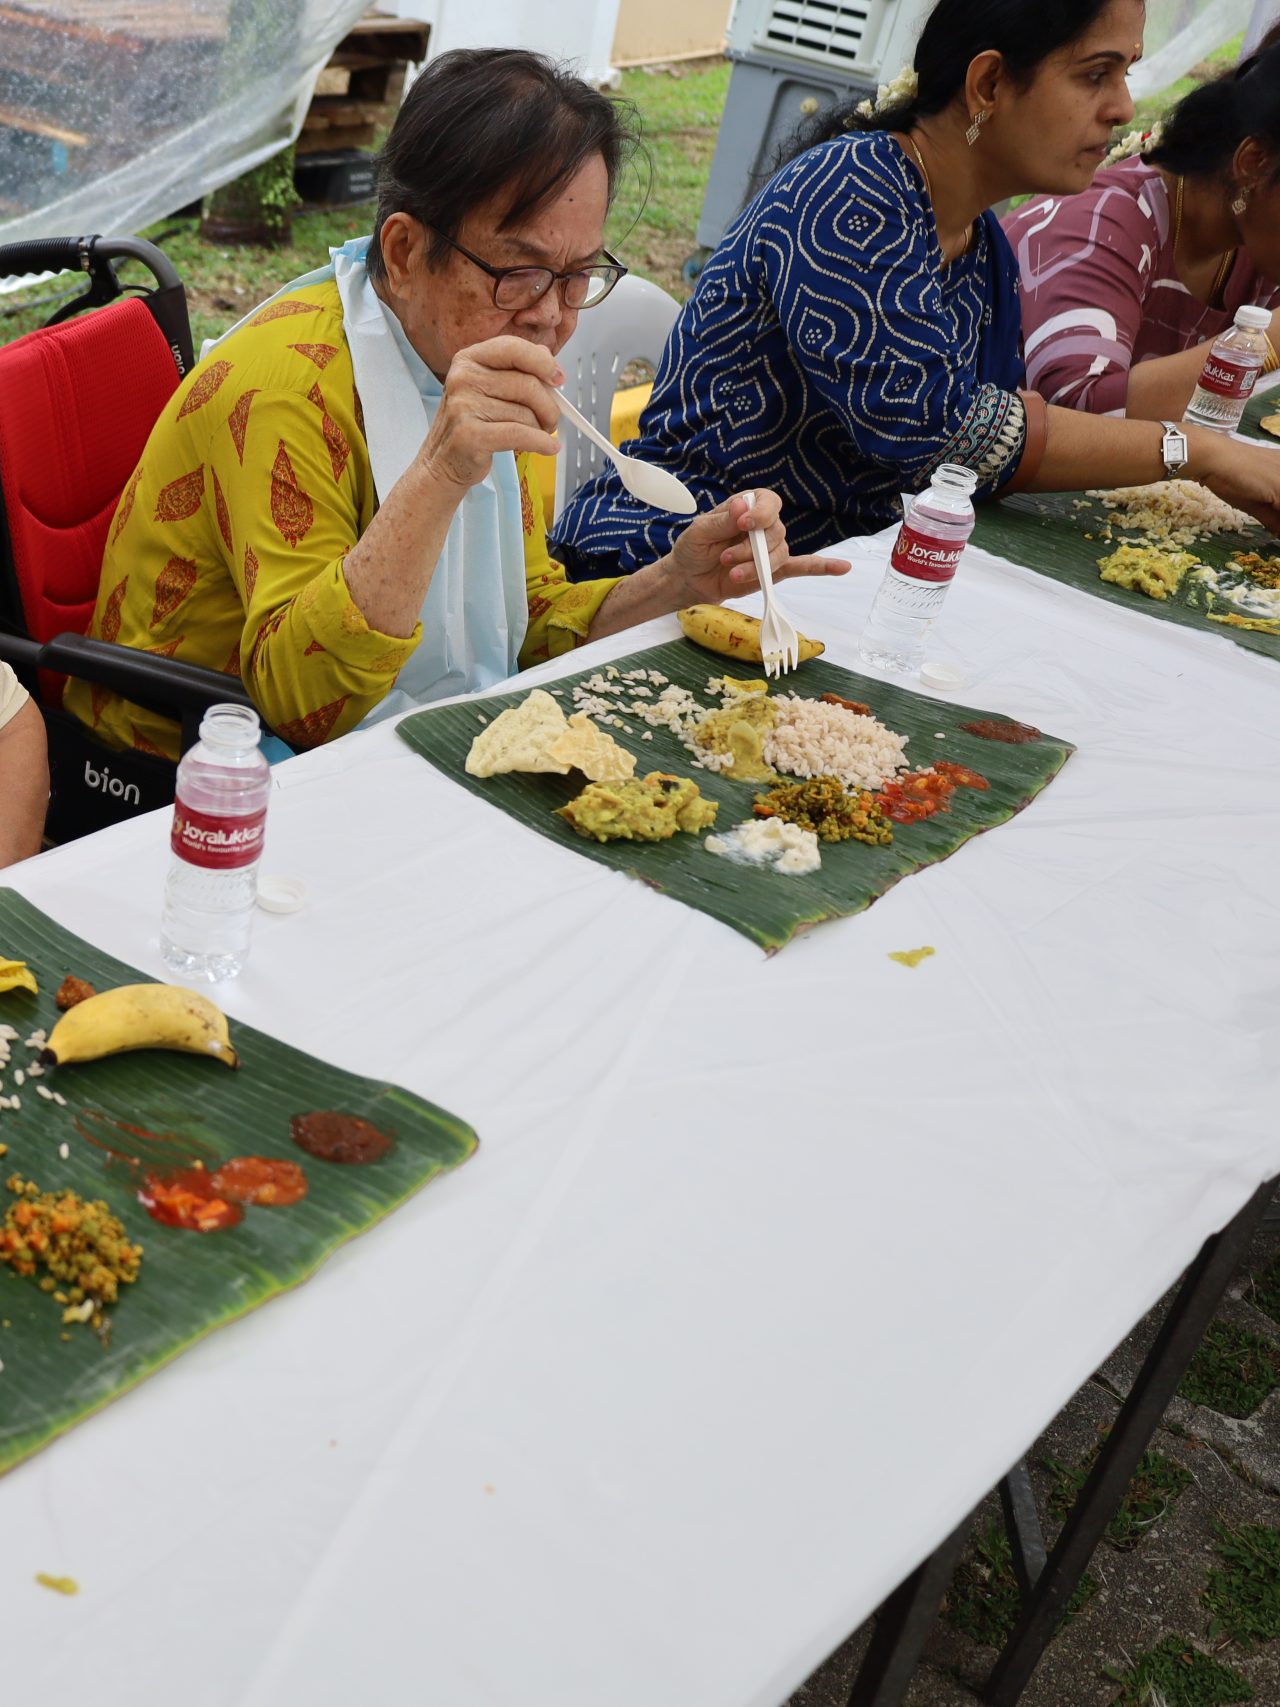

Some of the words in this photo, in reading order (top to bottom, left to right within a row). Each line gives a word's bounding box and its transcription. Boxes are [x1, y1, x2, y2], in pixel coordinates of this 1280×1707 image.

[1204, 362, 1235, 382] alukkas
[907, 554, 928, 566] World's
[84, 760, 140, 805] bion
